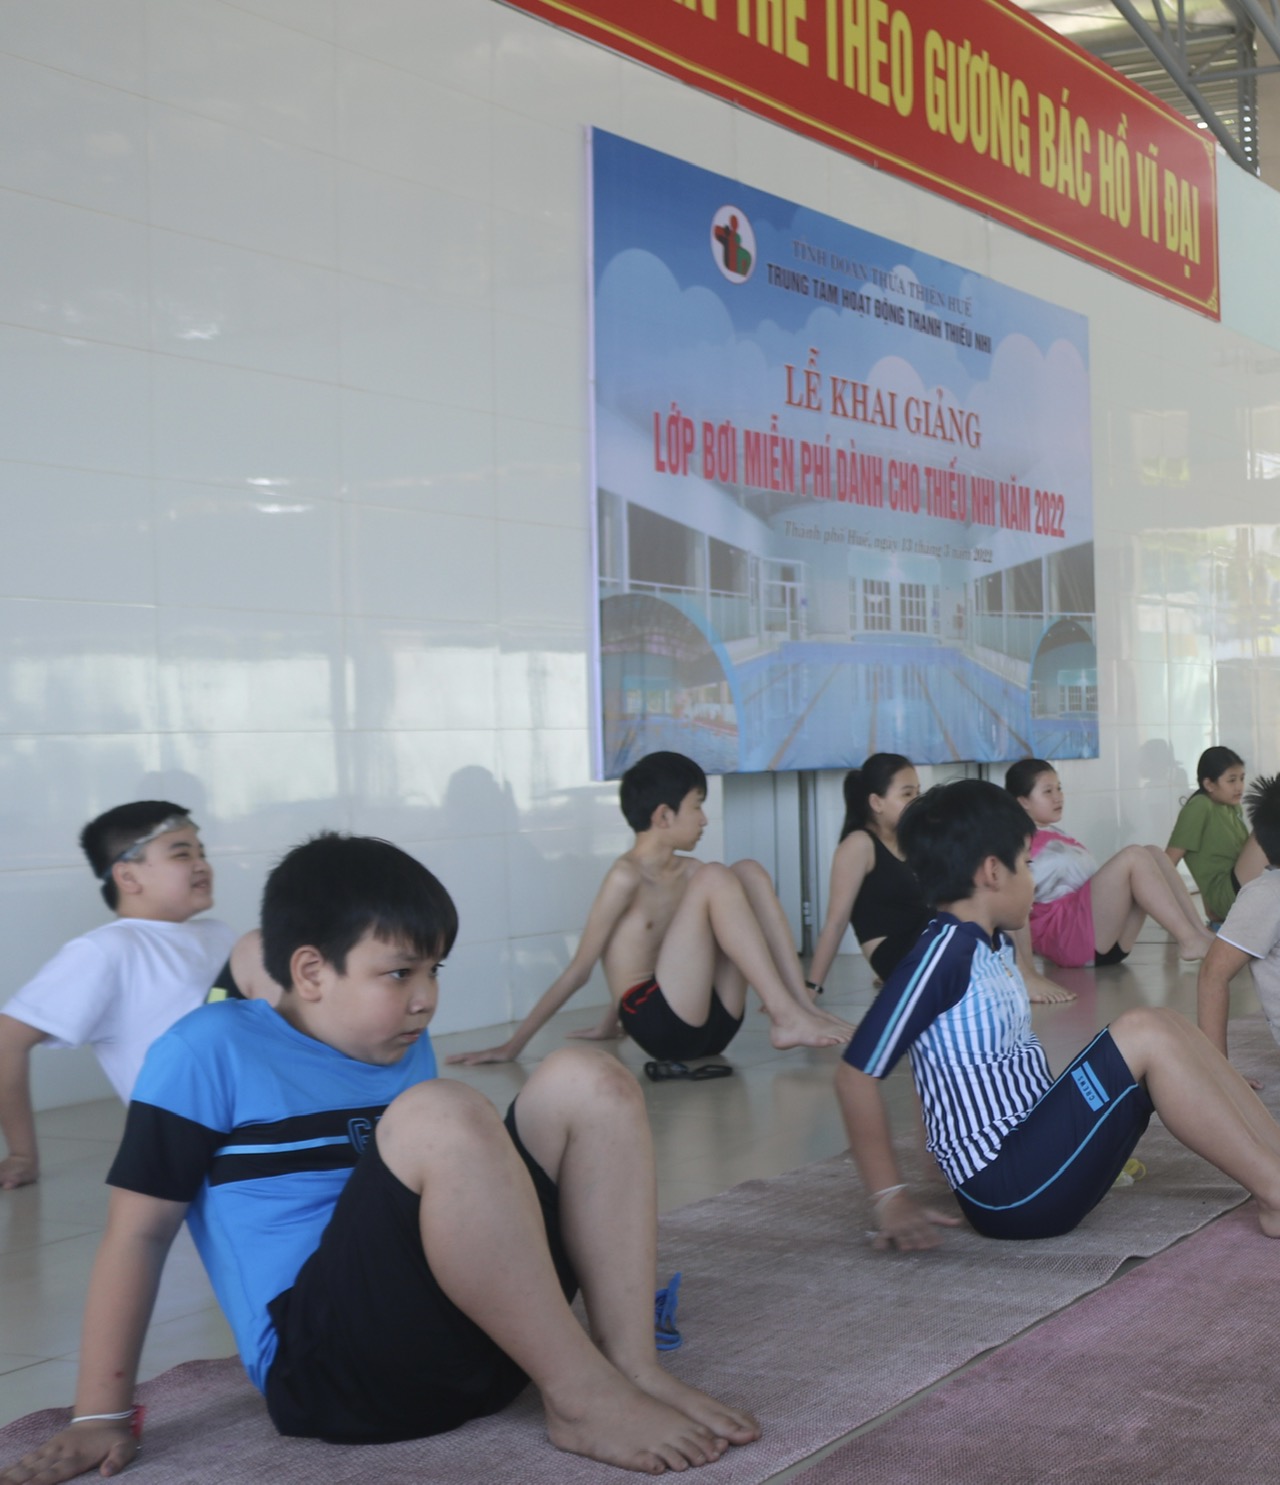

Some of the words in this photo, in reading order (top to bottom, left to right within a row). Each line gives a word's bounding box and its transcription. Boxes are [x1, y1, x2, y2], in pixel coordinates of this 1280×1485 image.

[825, 0, 914, 117] THEO
[924, 29, 1031, 178] GƯƠNG
[1038, 87, 1092, 208] BÁC
[1098, 113, 1131, 229] HỒ
[1136, 142, 1159, 244] VĨ
[1164, 168, 1200, 279] ĐẠI
[767, 263, 809, 296] TRUNG
[813, 277, 839, 306] TÂM
[841, 288, 871, 318] HOẠT
[874, 297, 905, 326] ĐỘNG
[908, 309, 942, 339] THANH
[944, 321, 973, 348] THIẾU
[975, 331, 992, 355] NHI
[947, 295, 973, 318] HUẾ
[784, 347, 822, 413] LỄ
[829, 375, 898, 430] KHAI
[904, 387, 982, 449] GIẢNG
[653, 401, 696, 477] LỚP
[702, 419, 738, 485] BƠI
[743, 414, 796, 496] MIỄN
[800, 433, 832, 499] PHÍ
[836, 439, 884, 509] DÀNH
[888, 458, 921, 515] CHO
[924, 456, 967, 523] THIẾU
[970, 474, 996, 527] NHI
[999, 473, 1032, 533] NĂM
[1034, 488, 1066, 539] 2022
